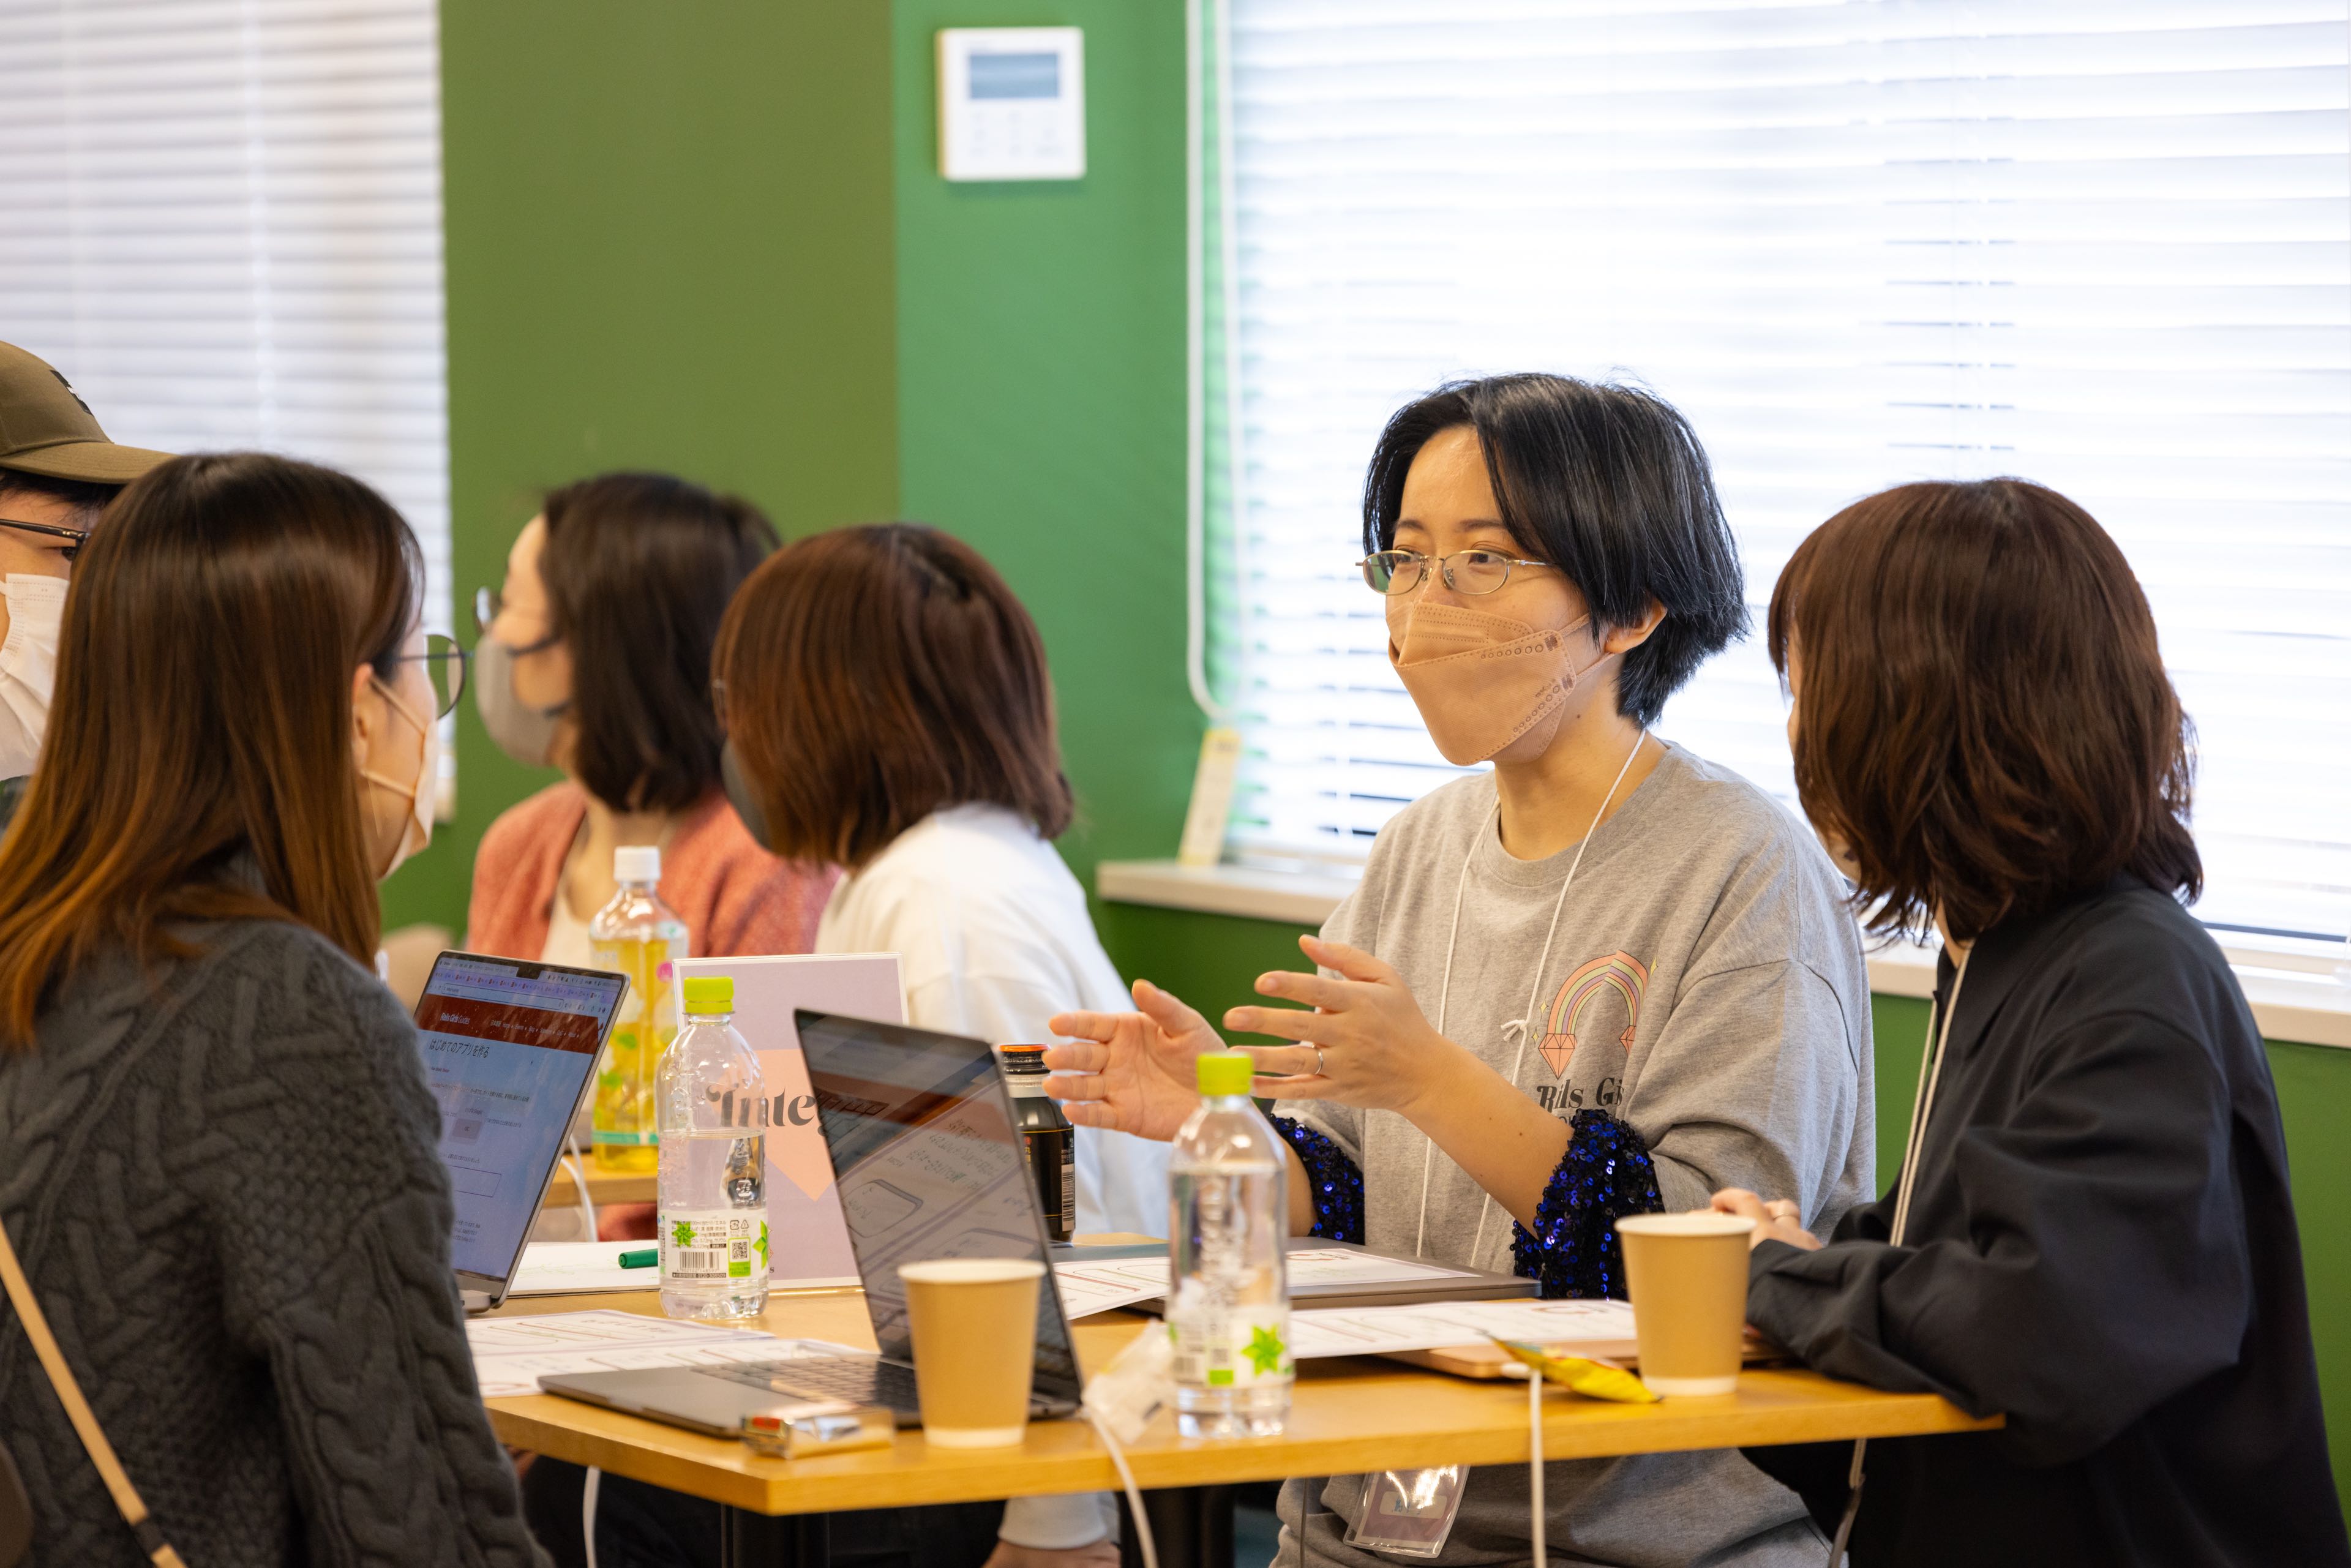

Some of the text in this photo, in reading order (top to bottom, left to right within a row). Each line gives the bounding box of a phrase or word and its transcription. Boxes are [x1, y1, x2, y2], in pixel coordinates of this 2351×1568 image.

[441, 1012, 450, 1021] Rails
[450, 1013, 459, 1023] Girls
[429, 1038, 490, 1058] はじめてのアプリを作る
[705, 1082, 827, 1136] Inte
